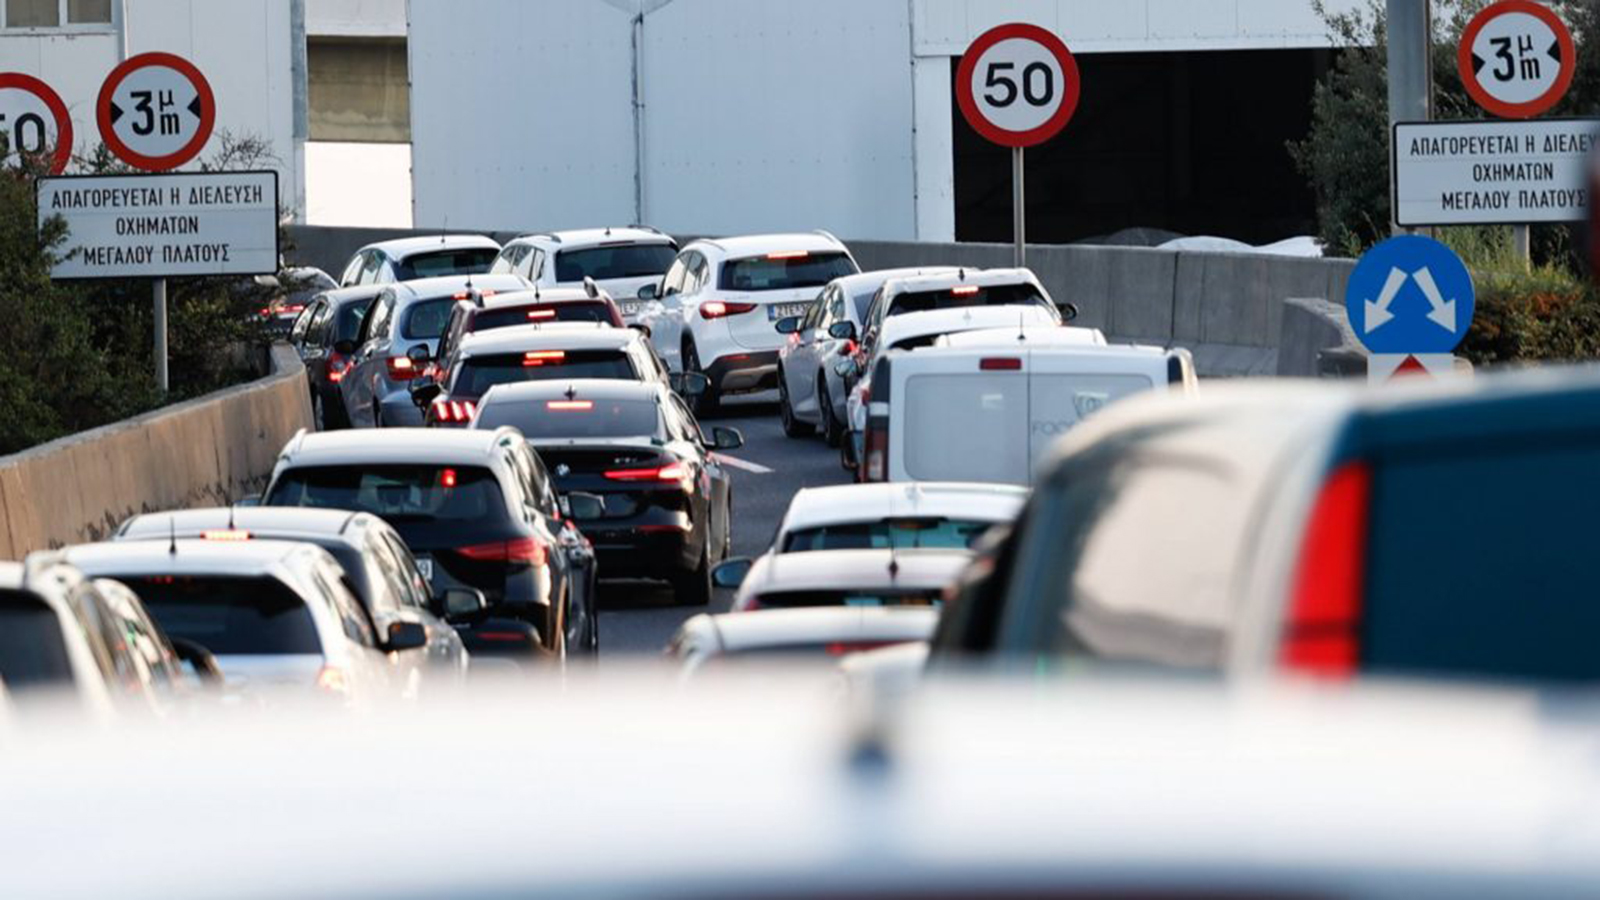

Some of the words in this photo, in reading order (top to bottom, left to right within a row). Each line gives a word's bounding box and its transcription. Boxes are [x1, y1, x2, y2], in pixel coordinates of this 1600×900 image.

[1489, 36, 1515, 82] 3
[983, 61, 1054, 108] 50
[130, 91, 155, 136] 3
[1410, 135, 1519, 156] ΑΠΑΓΟΡΕΥΕΤΑΙ
[1525, 135, 1535, 154] Η
[1473, 162, 1553, 182] ΟΧΗΜΑΤΩΝ
[52, 187, 163, 208] ΑΠΑΓΟΡΕΥΕΤΑΙ
[171, 187, 180, 206] Η
[189, 185, 262, 205] ΔΙΕΛΕΥΣΗ
[1442, 190, 1510, 211] ΜΕΓΑΛΟΥ
[1519, 188, 1587, 209] ΠΛΑΤΟΥΣ
[116, 215, 199, 236] ΟΧΗΜΑΤΩΝ
[84, 246, 154, 266] ΜΕΓΑΛΟΥ
[163, 244, 230, 263] ΠΛΑΤΟΥΣ
